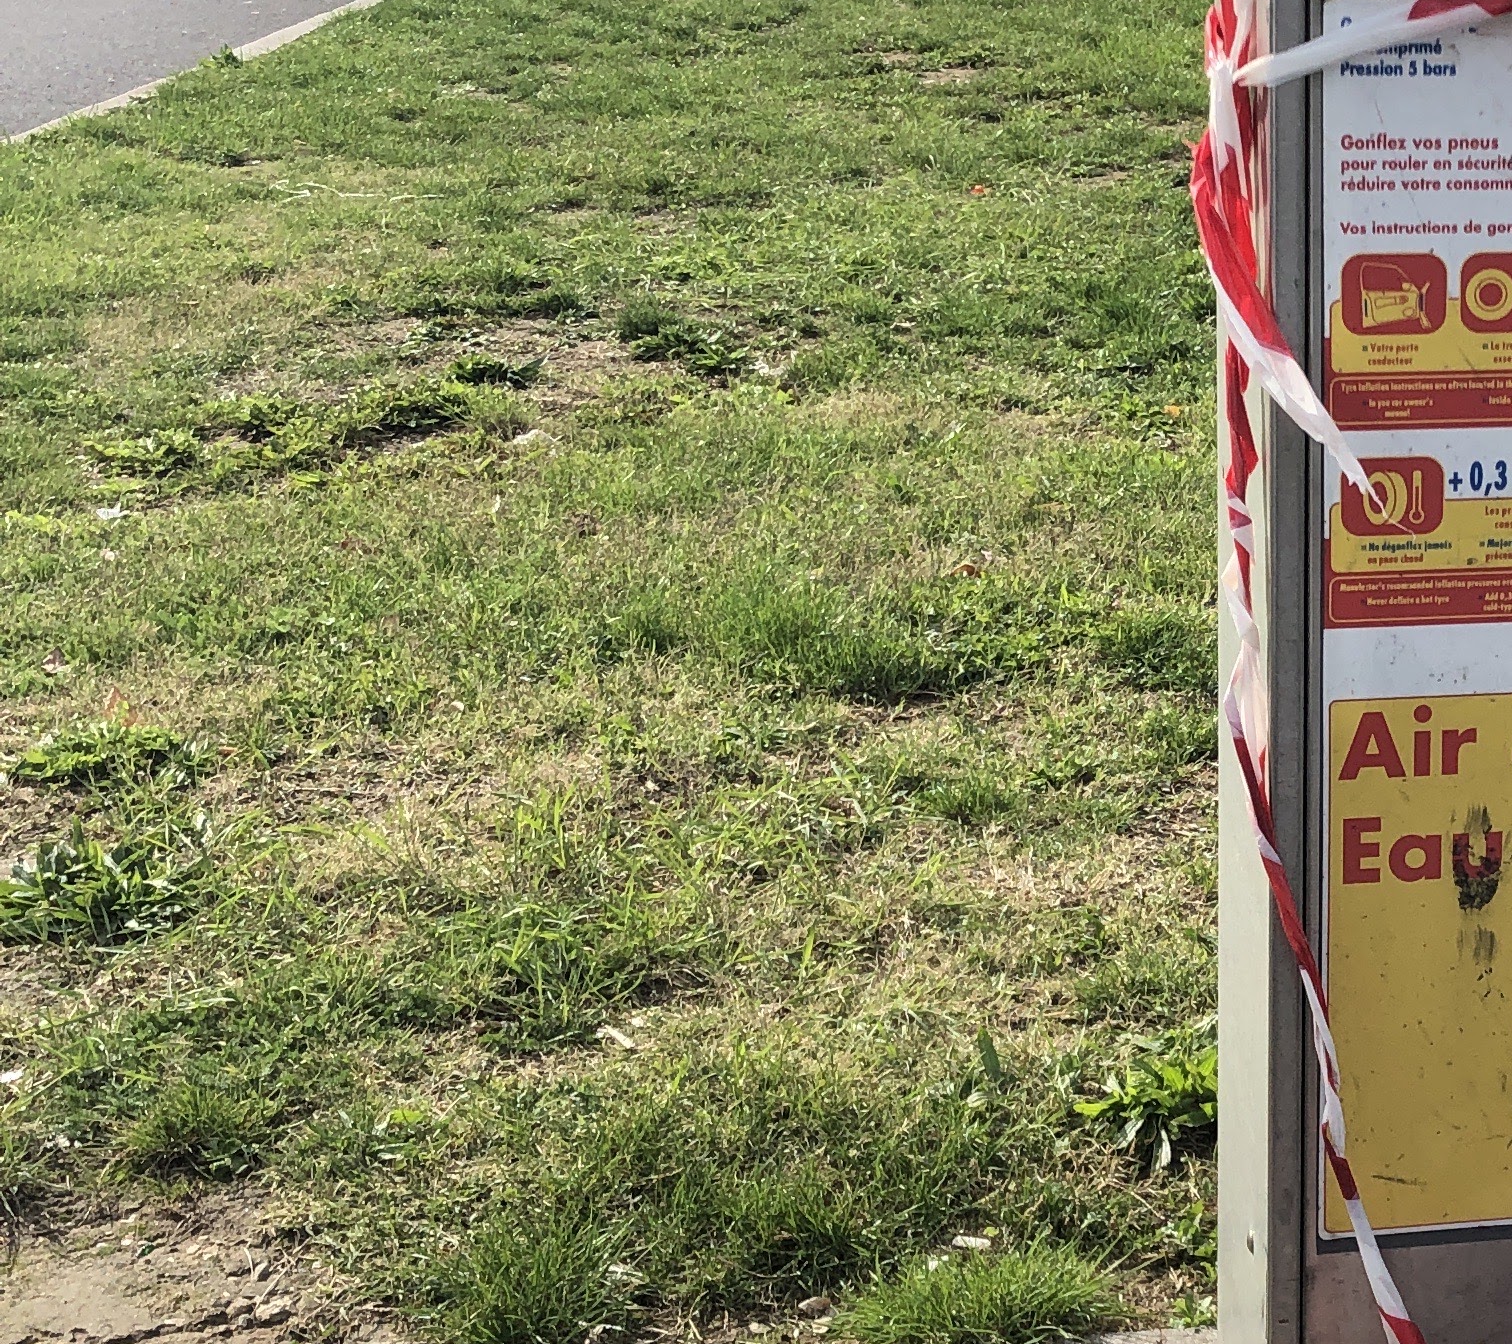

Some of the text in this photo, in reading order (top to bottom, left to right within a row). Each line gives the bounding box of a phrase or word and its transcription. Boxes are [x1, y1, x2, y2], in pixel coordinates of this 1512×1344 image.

[1340, 59, 1403, 77] Pression
[1423, 59, 1457, 76] bars
[1340, 132, 1499, 155] Gonflez vos pneus
[1340, 159, 1377, 175] pour
[1382, 154, 1428, 171] rouler
[1433, 160, 1452, 171] en
[1340, 175, 1396, 191] réduire
[1401, 177, 1441, 191] votre
[1340, 221, 1367, 235] Vos
[1372, 220, 1458, 235] instructions
[1464, 219, 1482, 234] de
[1370, 343, 1418, 355] Votre porte
[1368, 356, 1412, 366] conducteur
[1470, 460, 1507, 496] 0,3
[1485, 506, 1500, 516] Les
[1338, 704, 1477, 781] Air
[1342, 816, 1503, 884] Eau
